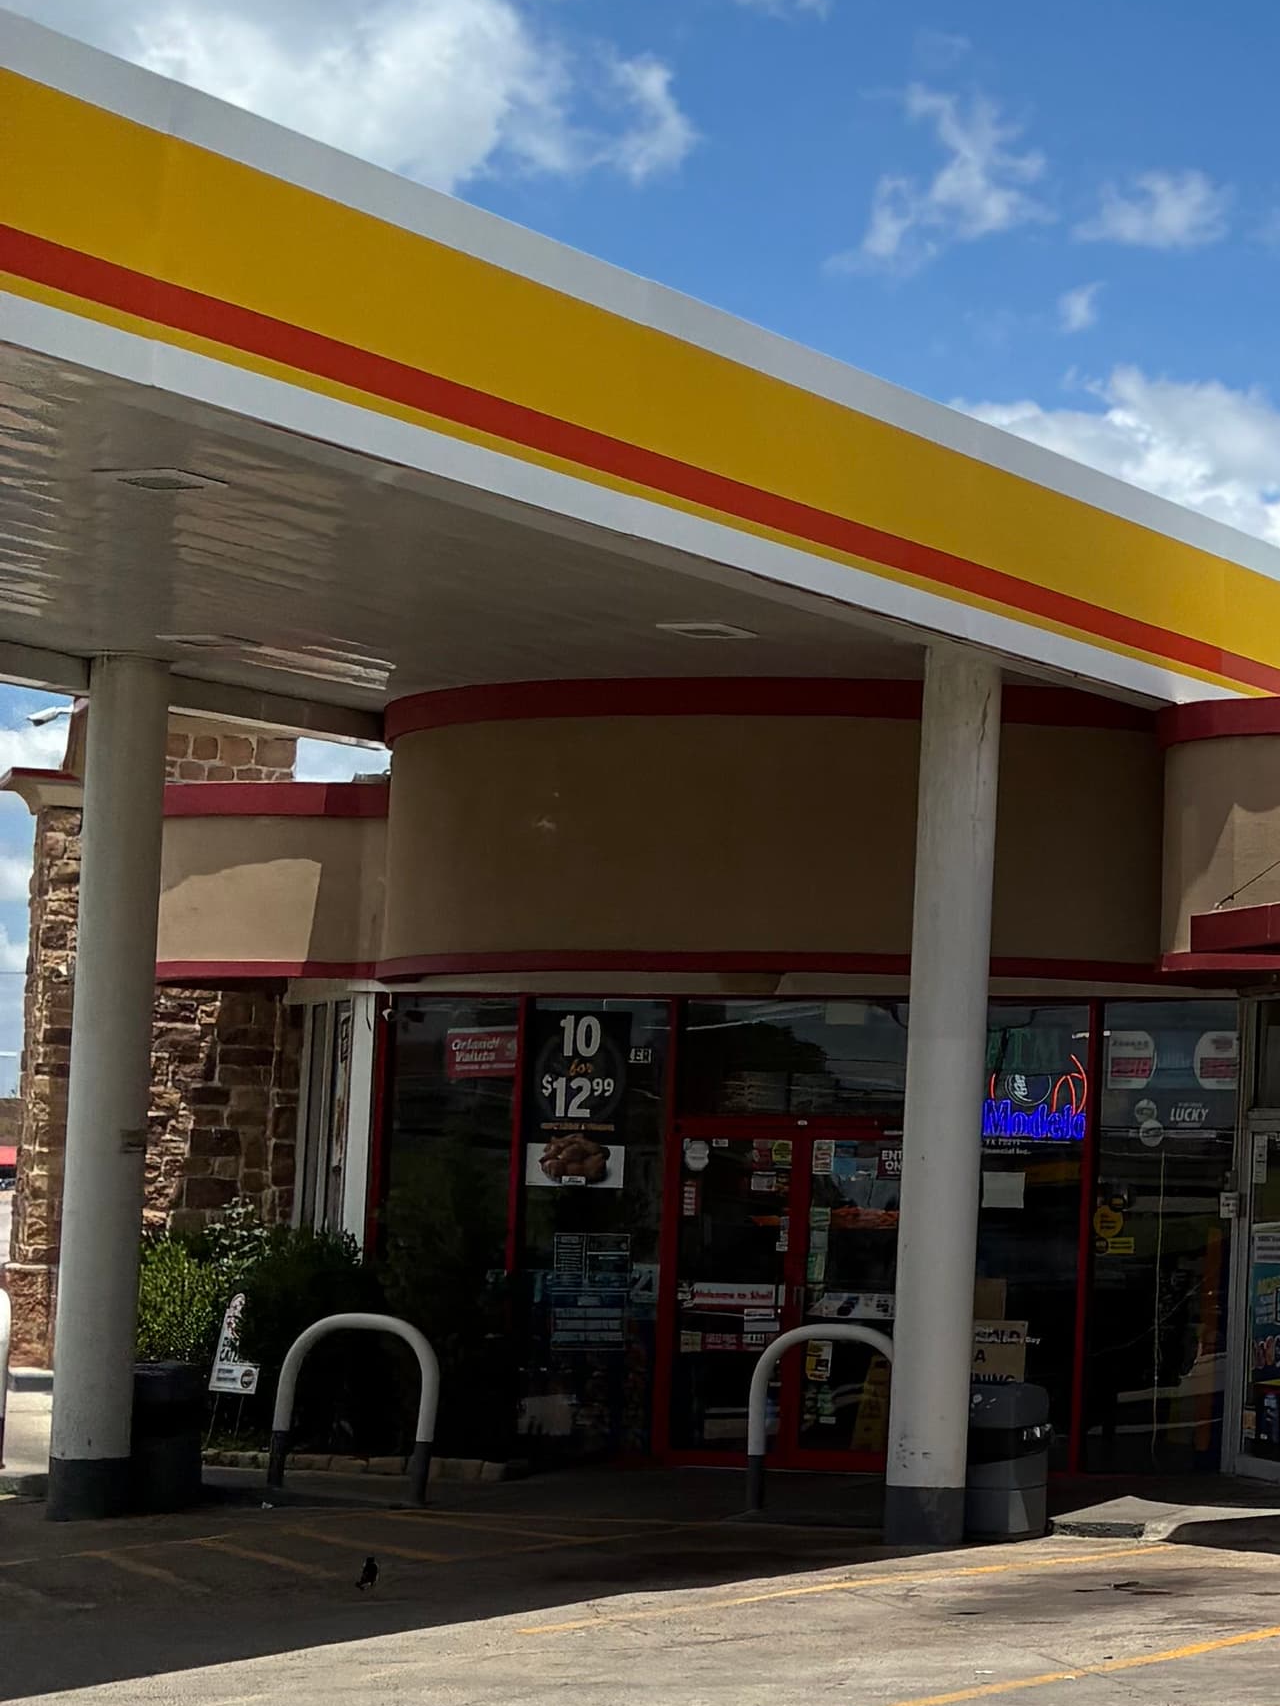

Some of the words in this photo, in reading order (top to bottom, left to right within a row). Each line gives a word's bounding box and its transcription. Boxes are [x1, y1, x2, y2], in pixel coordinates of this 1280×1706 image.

[560, 1014, 601, 1058] 10
[982, 1097, 1088, 1140] Modelo
[1169, 1107, 1209, 1122] LUCKY
